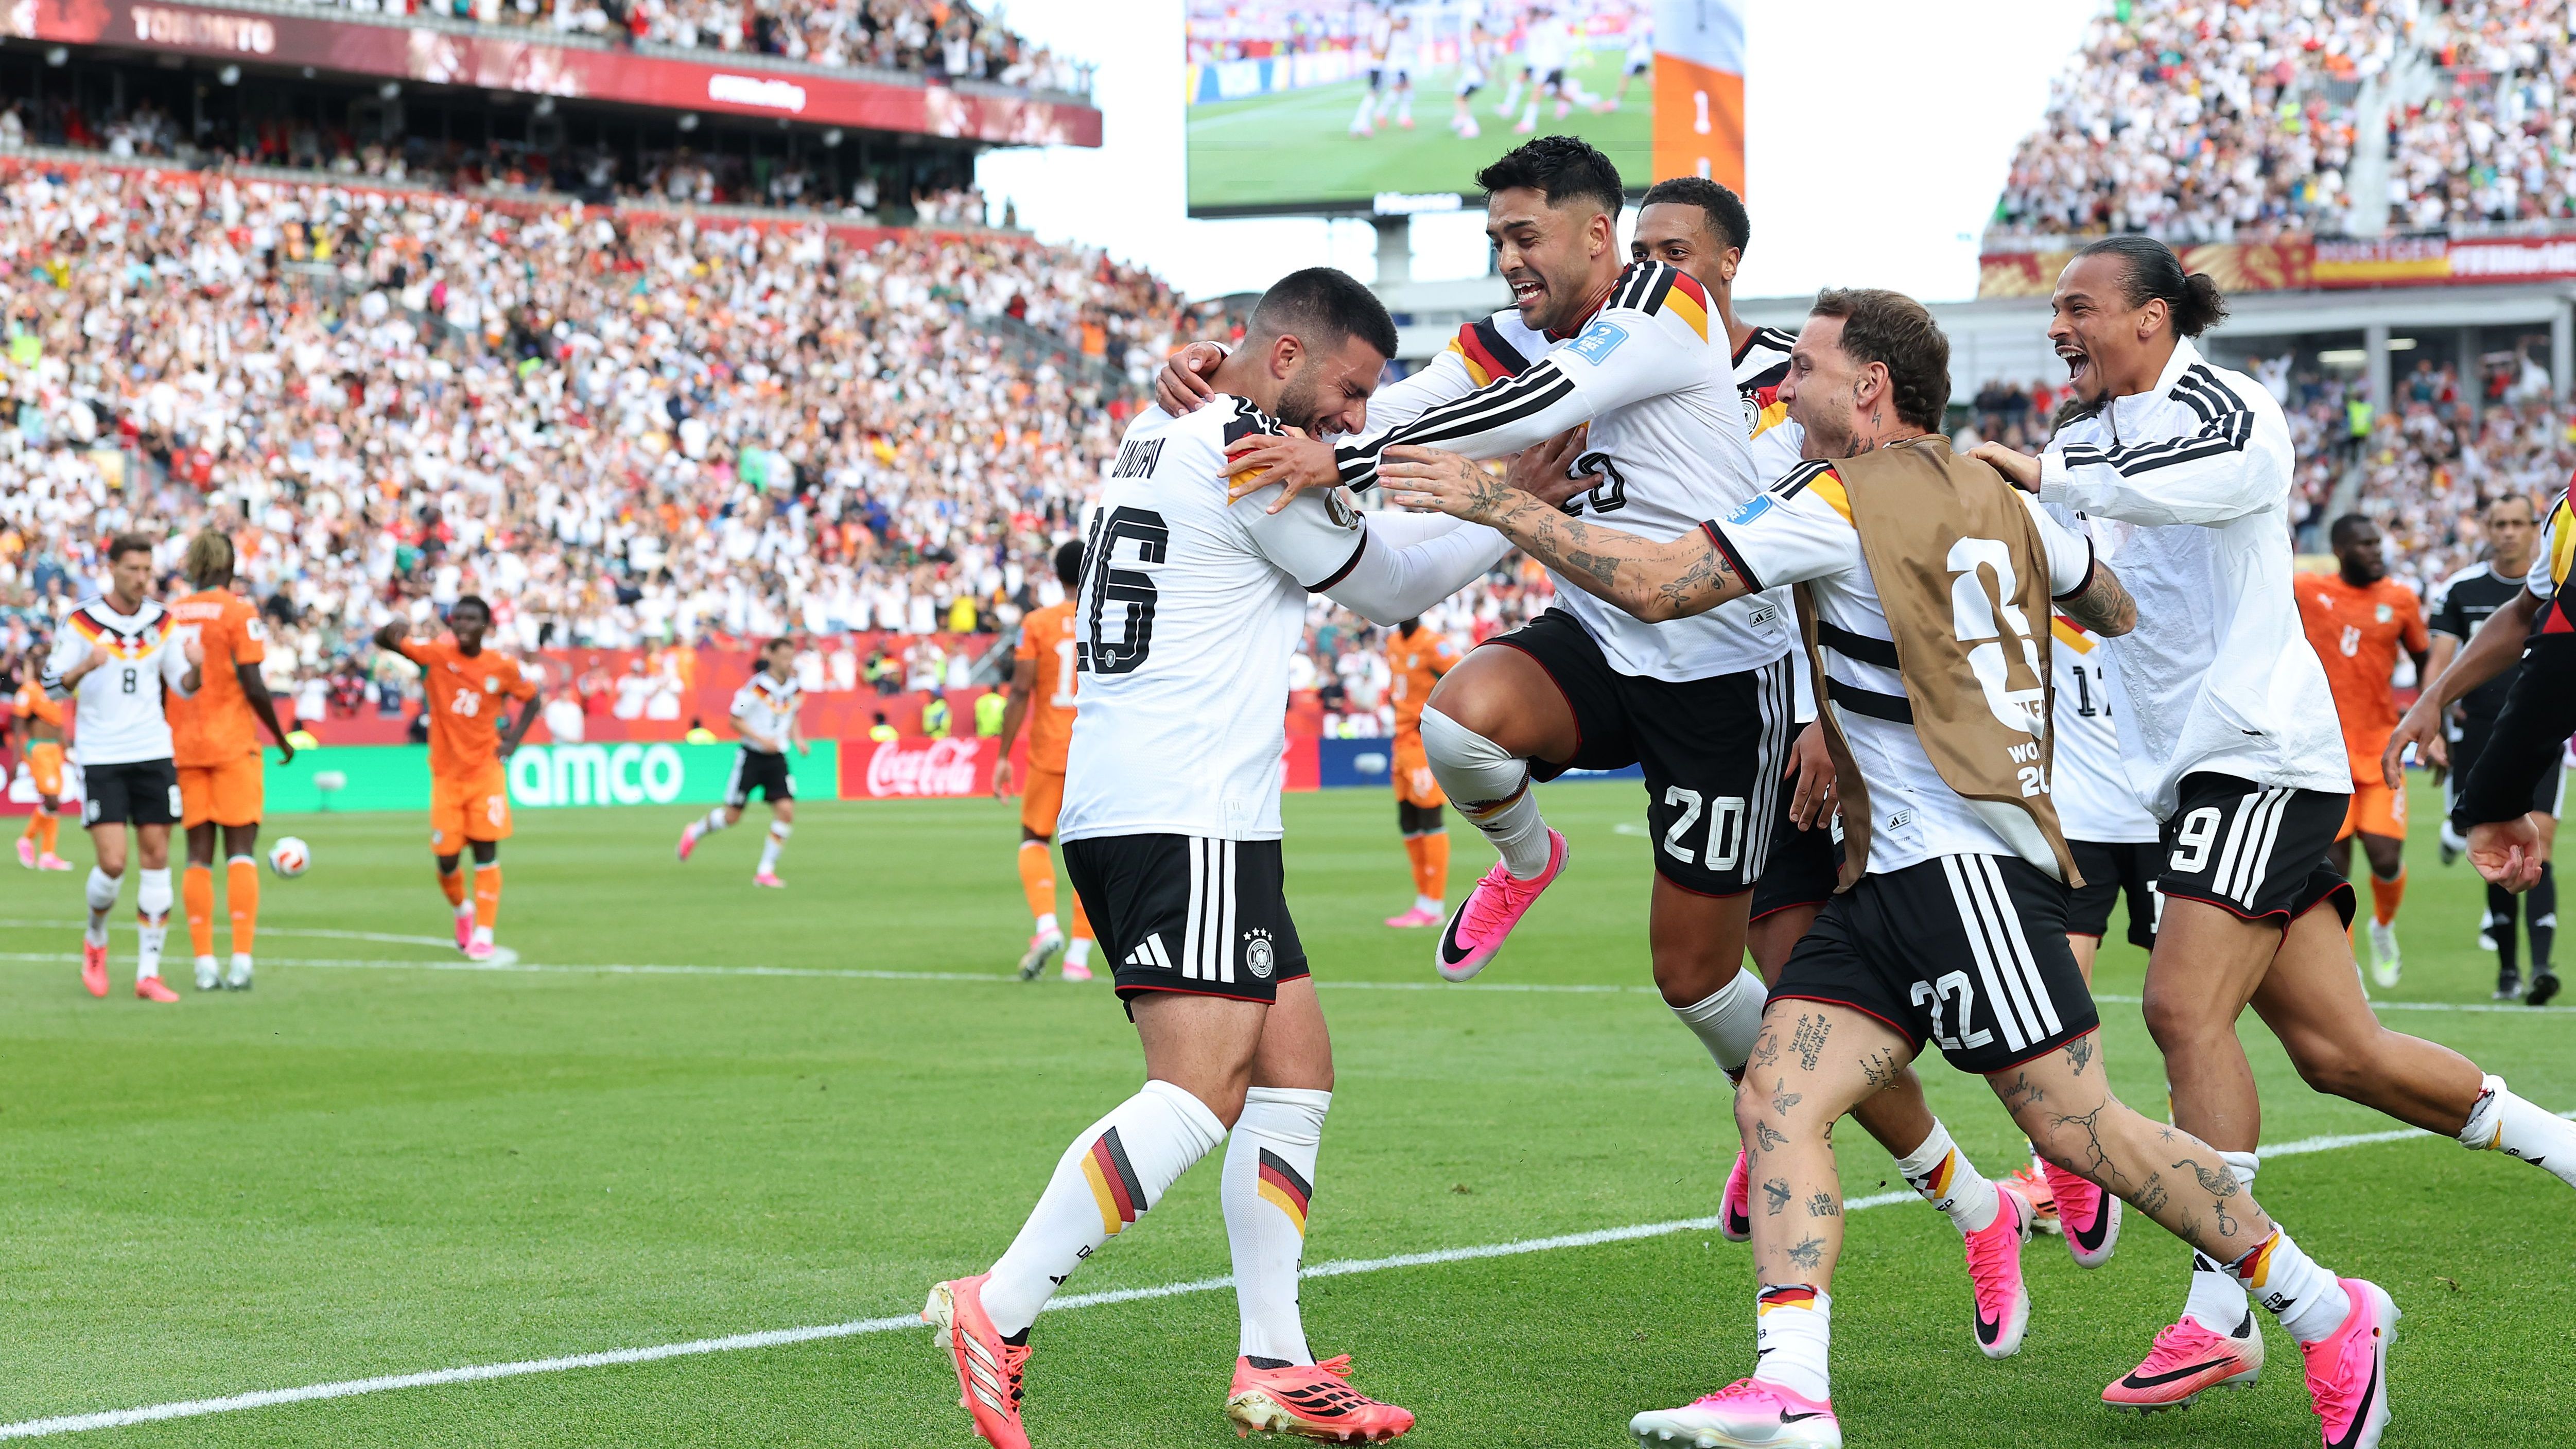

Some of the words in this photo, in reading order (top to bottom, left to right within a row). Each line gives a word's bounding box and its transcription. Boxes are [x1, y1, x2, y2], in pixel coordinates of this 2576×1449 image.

[130, 6, 276, 54] TORONTO
[1112, 438, 1166, 479] UNDAV
[123, 668, 136, 693] 8
[1664, 785, 1745, 870] 20
[2170, 807, 2222, 874] 9
[1910, 970, 1994, 1050] 22
[1788, 1039, 1799, 1052] You
[1798, 1014, 1808, 1027] the
[1799, 1023, 1813, 1054] greatest
[1801, 1043, 1814, 1071] project
[1810, 1028, 1820, 1042] you
[1817, 1014, 1825, 1028] will
[1809, 1054, 1818, 1071] ever
[1814, 1035, 1826, 1053] work
